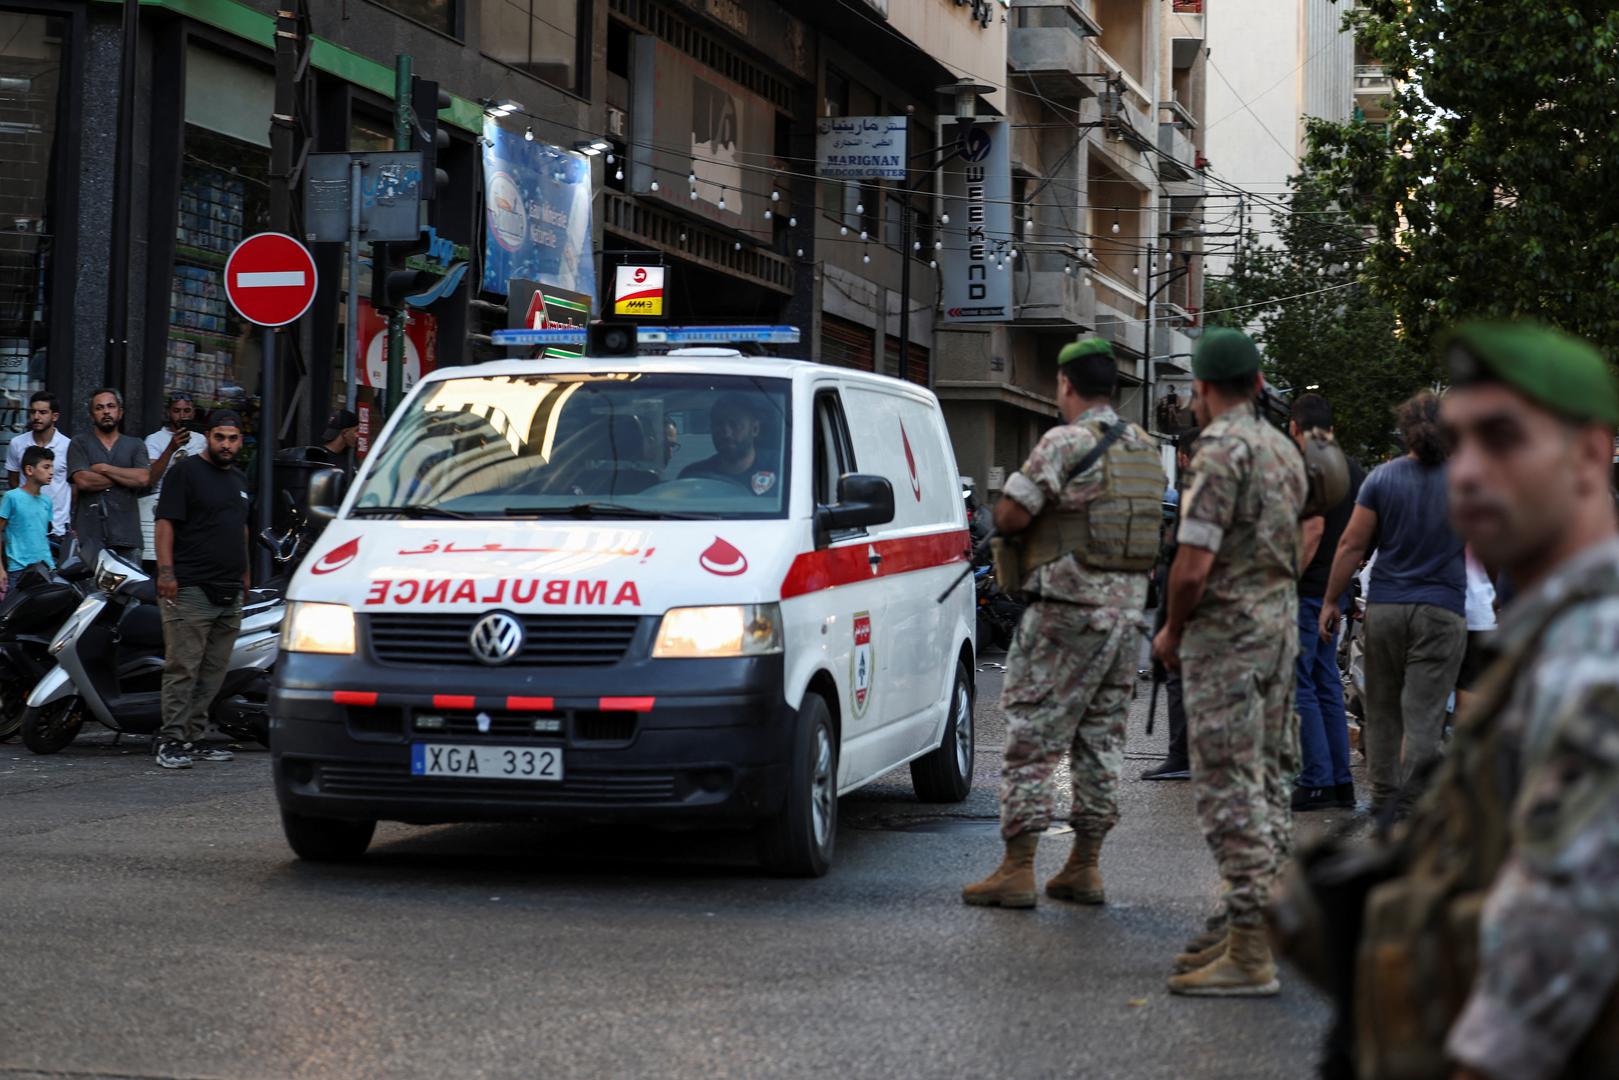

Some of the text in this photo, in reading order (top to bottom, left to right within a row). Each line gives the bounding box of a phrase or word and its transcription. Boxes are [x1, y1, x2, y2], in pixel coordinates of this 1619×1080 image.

[827, 155, 900, 166] MARIGNAN
[866, 168, 907, 177] CENTER
[429, 747, 555, 776] XGA 332
